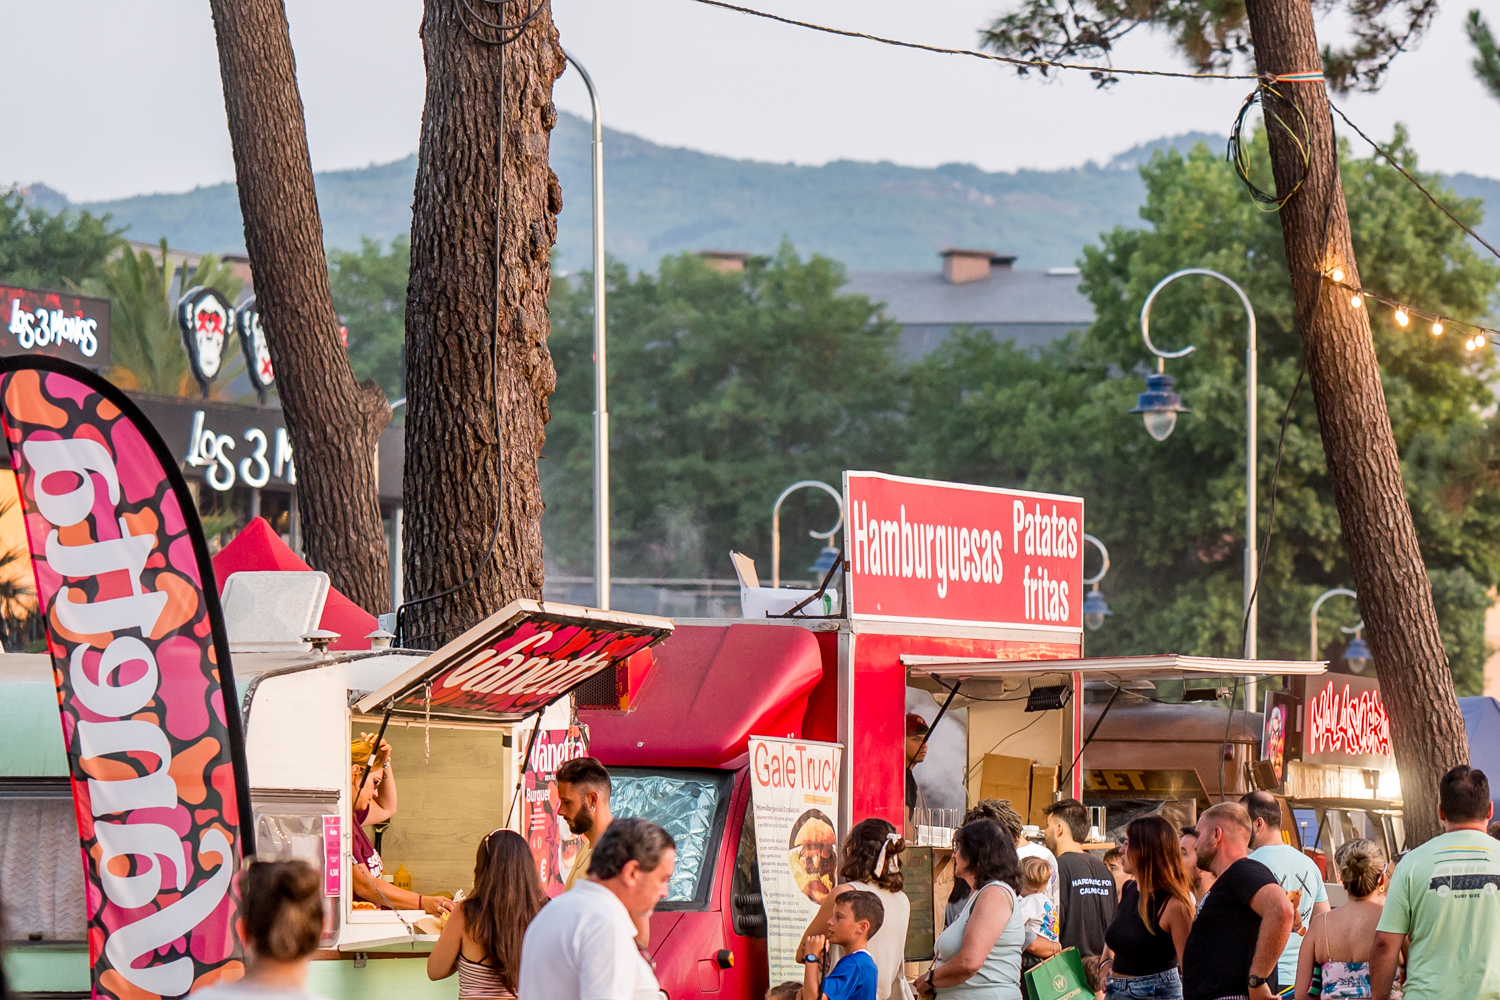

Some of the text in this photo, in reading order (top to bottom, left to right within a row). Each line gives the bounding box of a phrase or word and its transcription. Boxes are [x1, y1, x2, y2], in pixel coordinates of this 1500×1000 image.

[34, 308, 51, 347] 3
[239, 427, 271, 489] 3
[853, 499, 1079, 599] Hamburguesas Patatas
[1023, 564, 1070, 623] fritas
[443, 631, 609, 695] Vanetta
[526, 787, 551, 806] Burguer
